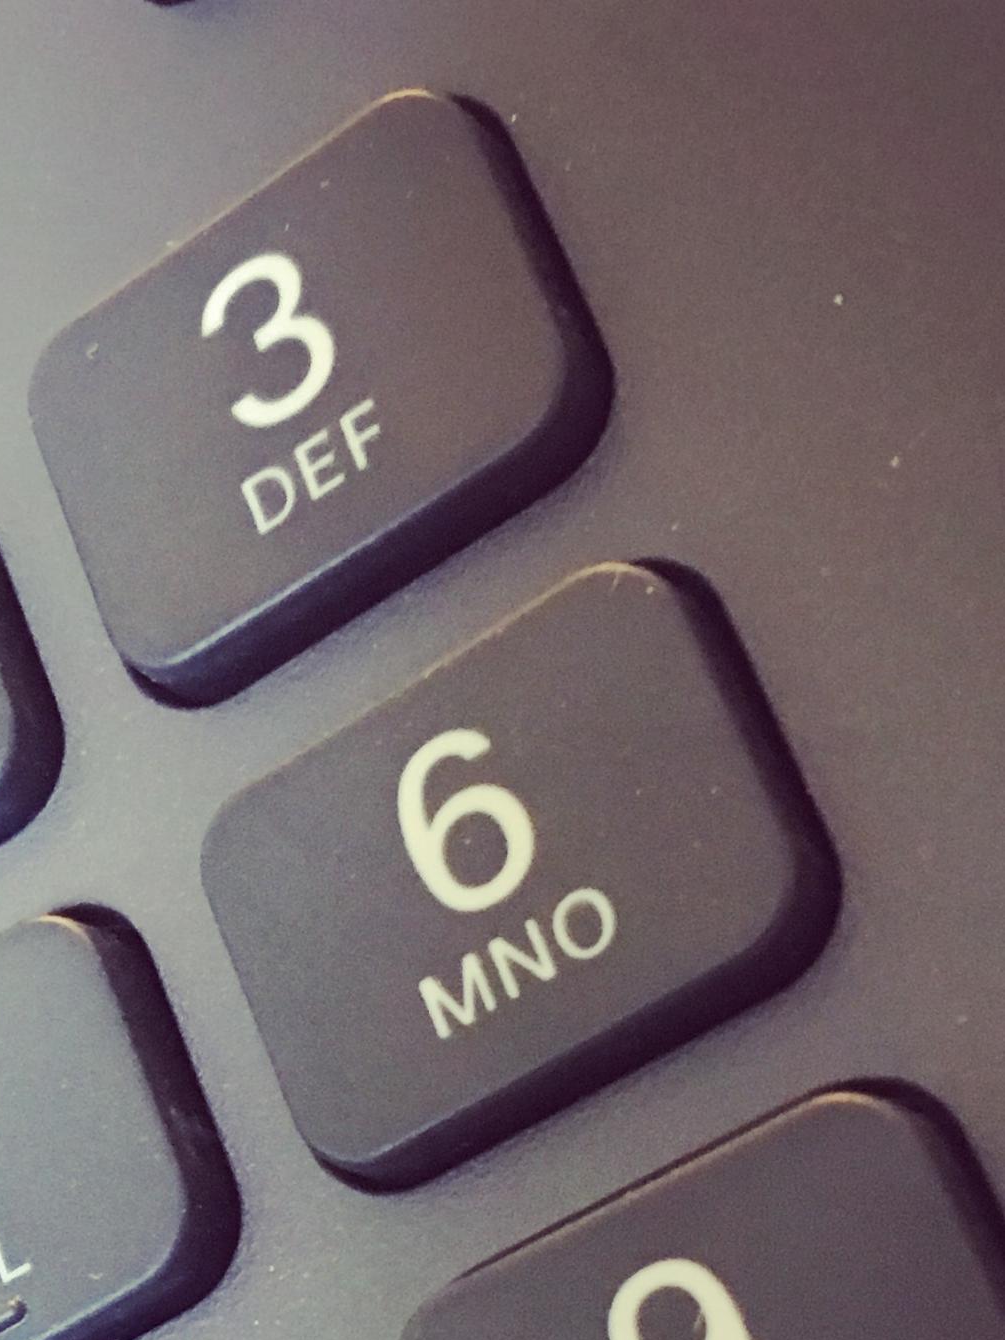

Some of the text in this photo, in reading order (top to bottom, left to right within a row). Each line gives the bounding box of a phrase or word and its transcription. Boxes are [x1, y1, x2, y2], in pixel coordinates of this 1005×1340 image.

[201, 252, 336, 428] 3
[241, 399, 380, 535] DEF
[396, 728, 536, 913] 6
[417, 886, 617, 1040] MNO
